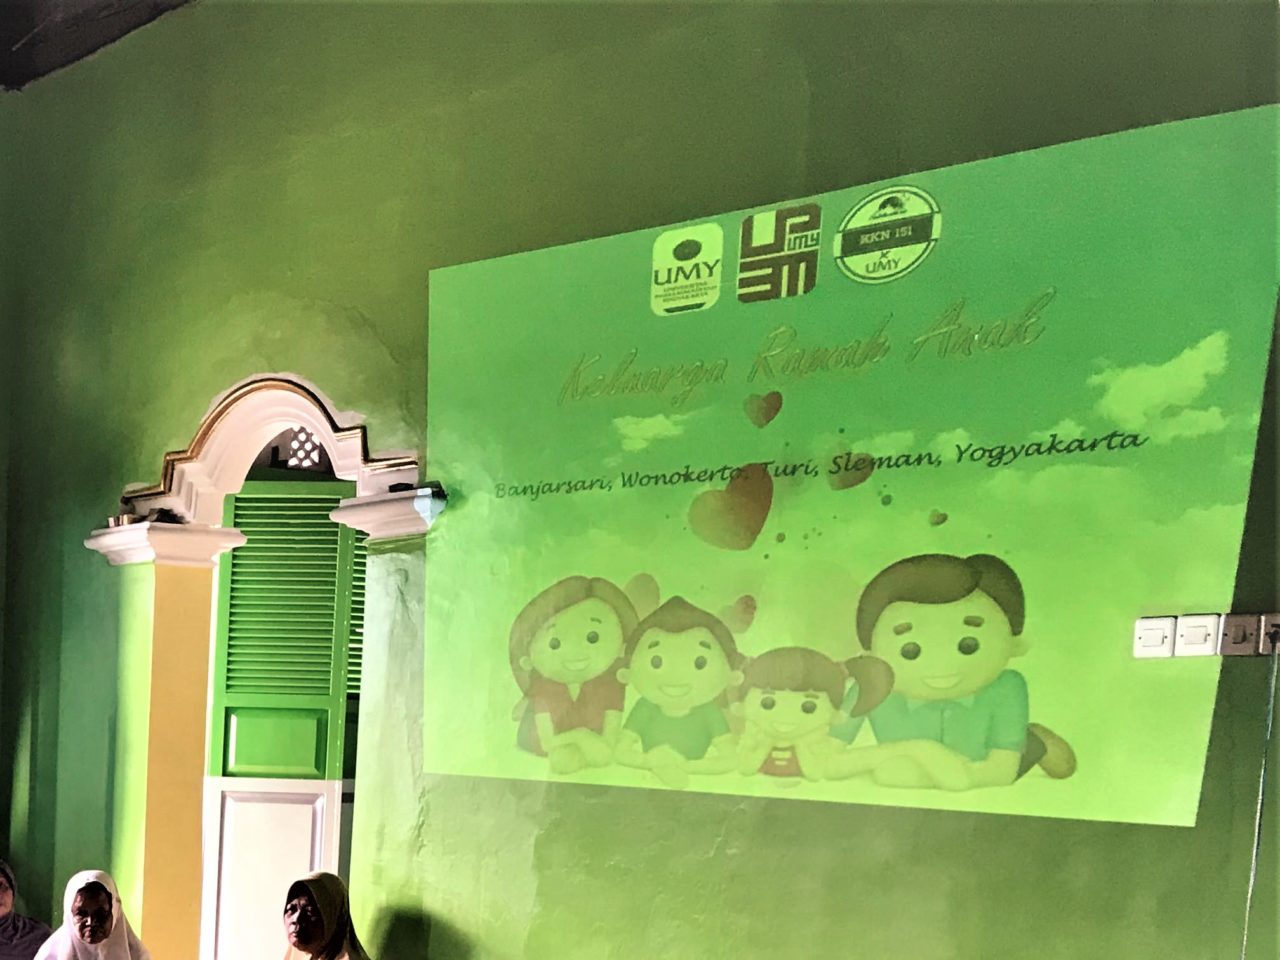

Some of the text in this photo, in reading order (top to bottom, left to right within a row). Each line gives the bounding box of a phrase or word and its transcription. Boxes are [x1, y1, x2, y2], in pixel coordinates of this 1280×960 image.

[653, 257, 721, 286] UMY
[865, 258, 901, 273] UMY
[494, 475, 614, 502] Banjarsari,
[828, 449, 942, 475] Sleman,
[955, 430, 1150, 468] Yogyakarta
